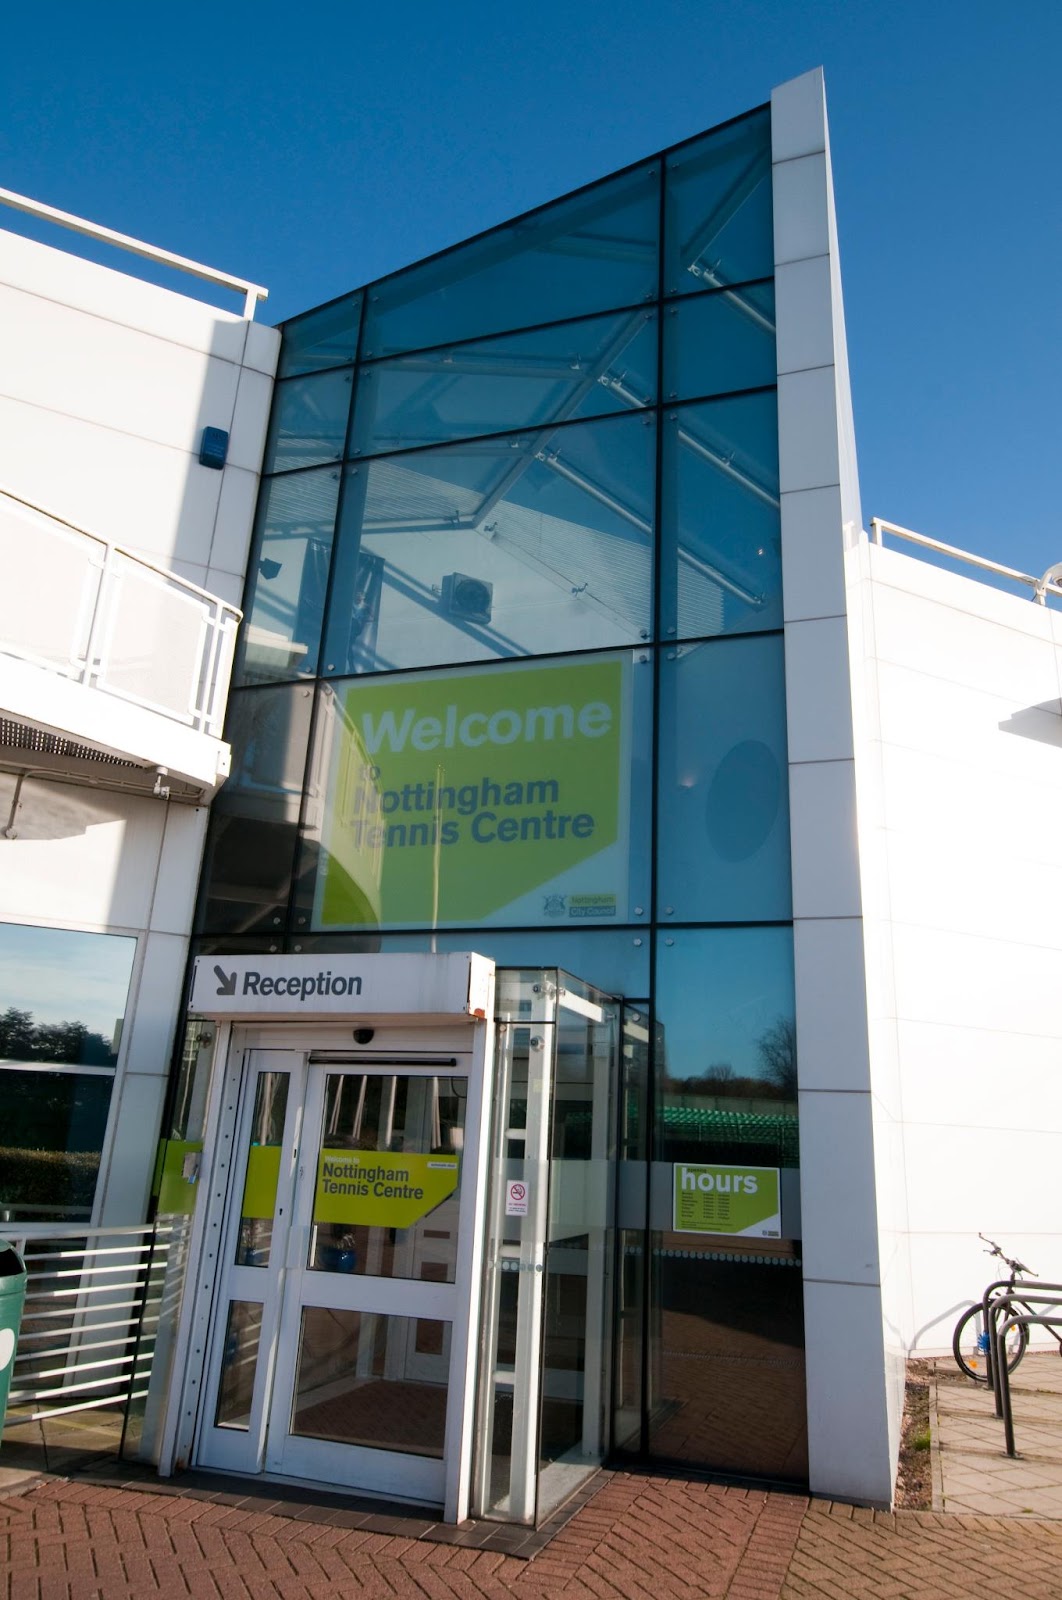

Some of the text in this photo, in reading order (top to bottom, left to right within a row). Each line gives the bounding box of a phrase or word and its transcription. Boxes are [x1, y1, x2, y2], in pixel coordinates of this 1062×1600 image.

[361, 702, 611, 754] Welcome
[353, 777, 559, 816] Nottingham
[351, 812, 595, 849] Tennis Centre
[571, 907, 585, 917] City
[242, 970, 362, 1001] Reception
[323, 1163, 409, 1182] Nottingham
[325, 1155, 350, 1164] Welcome
[322, 1178, 424, 1200] Tennis Centre
[681, 1167, 758, 1194] hours
